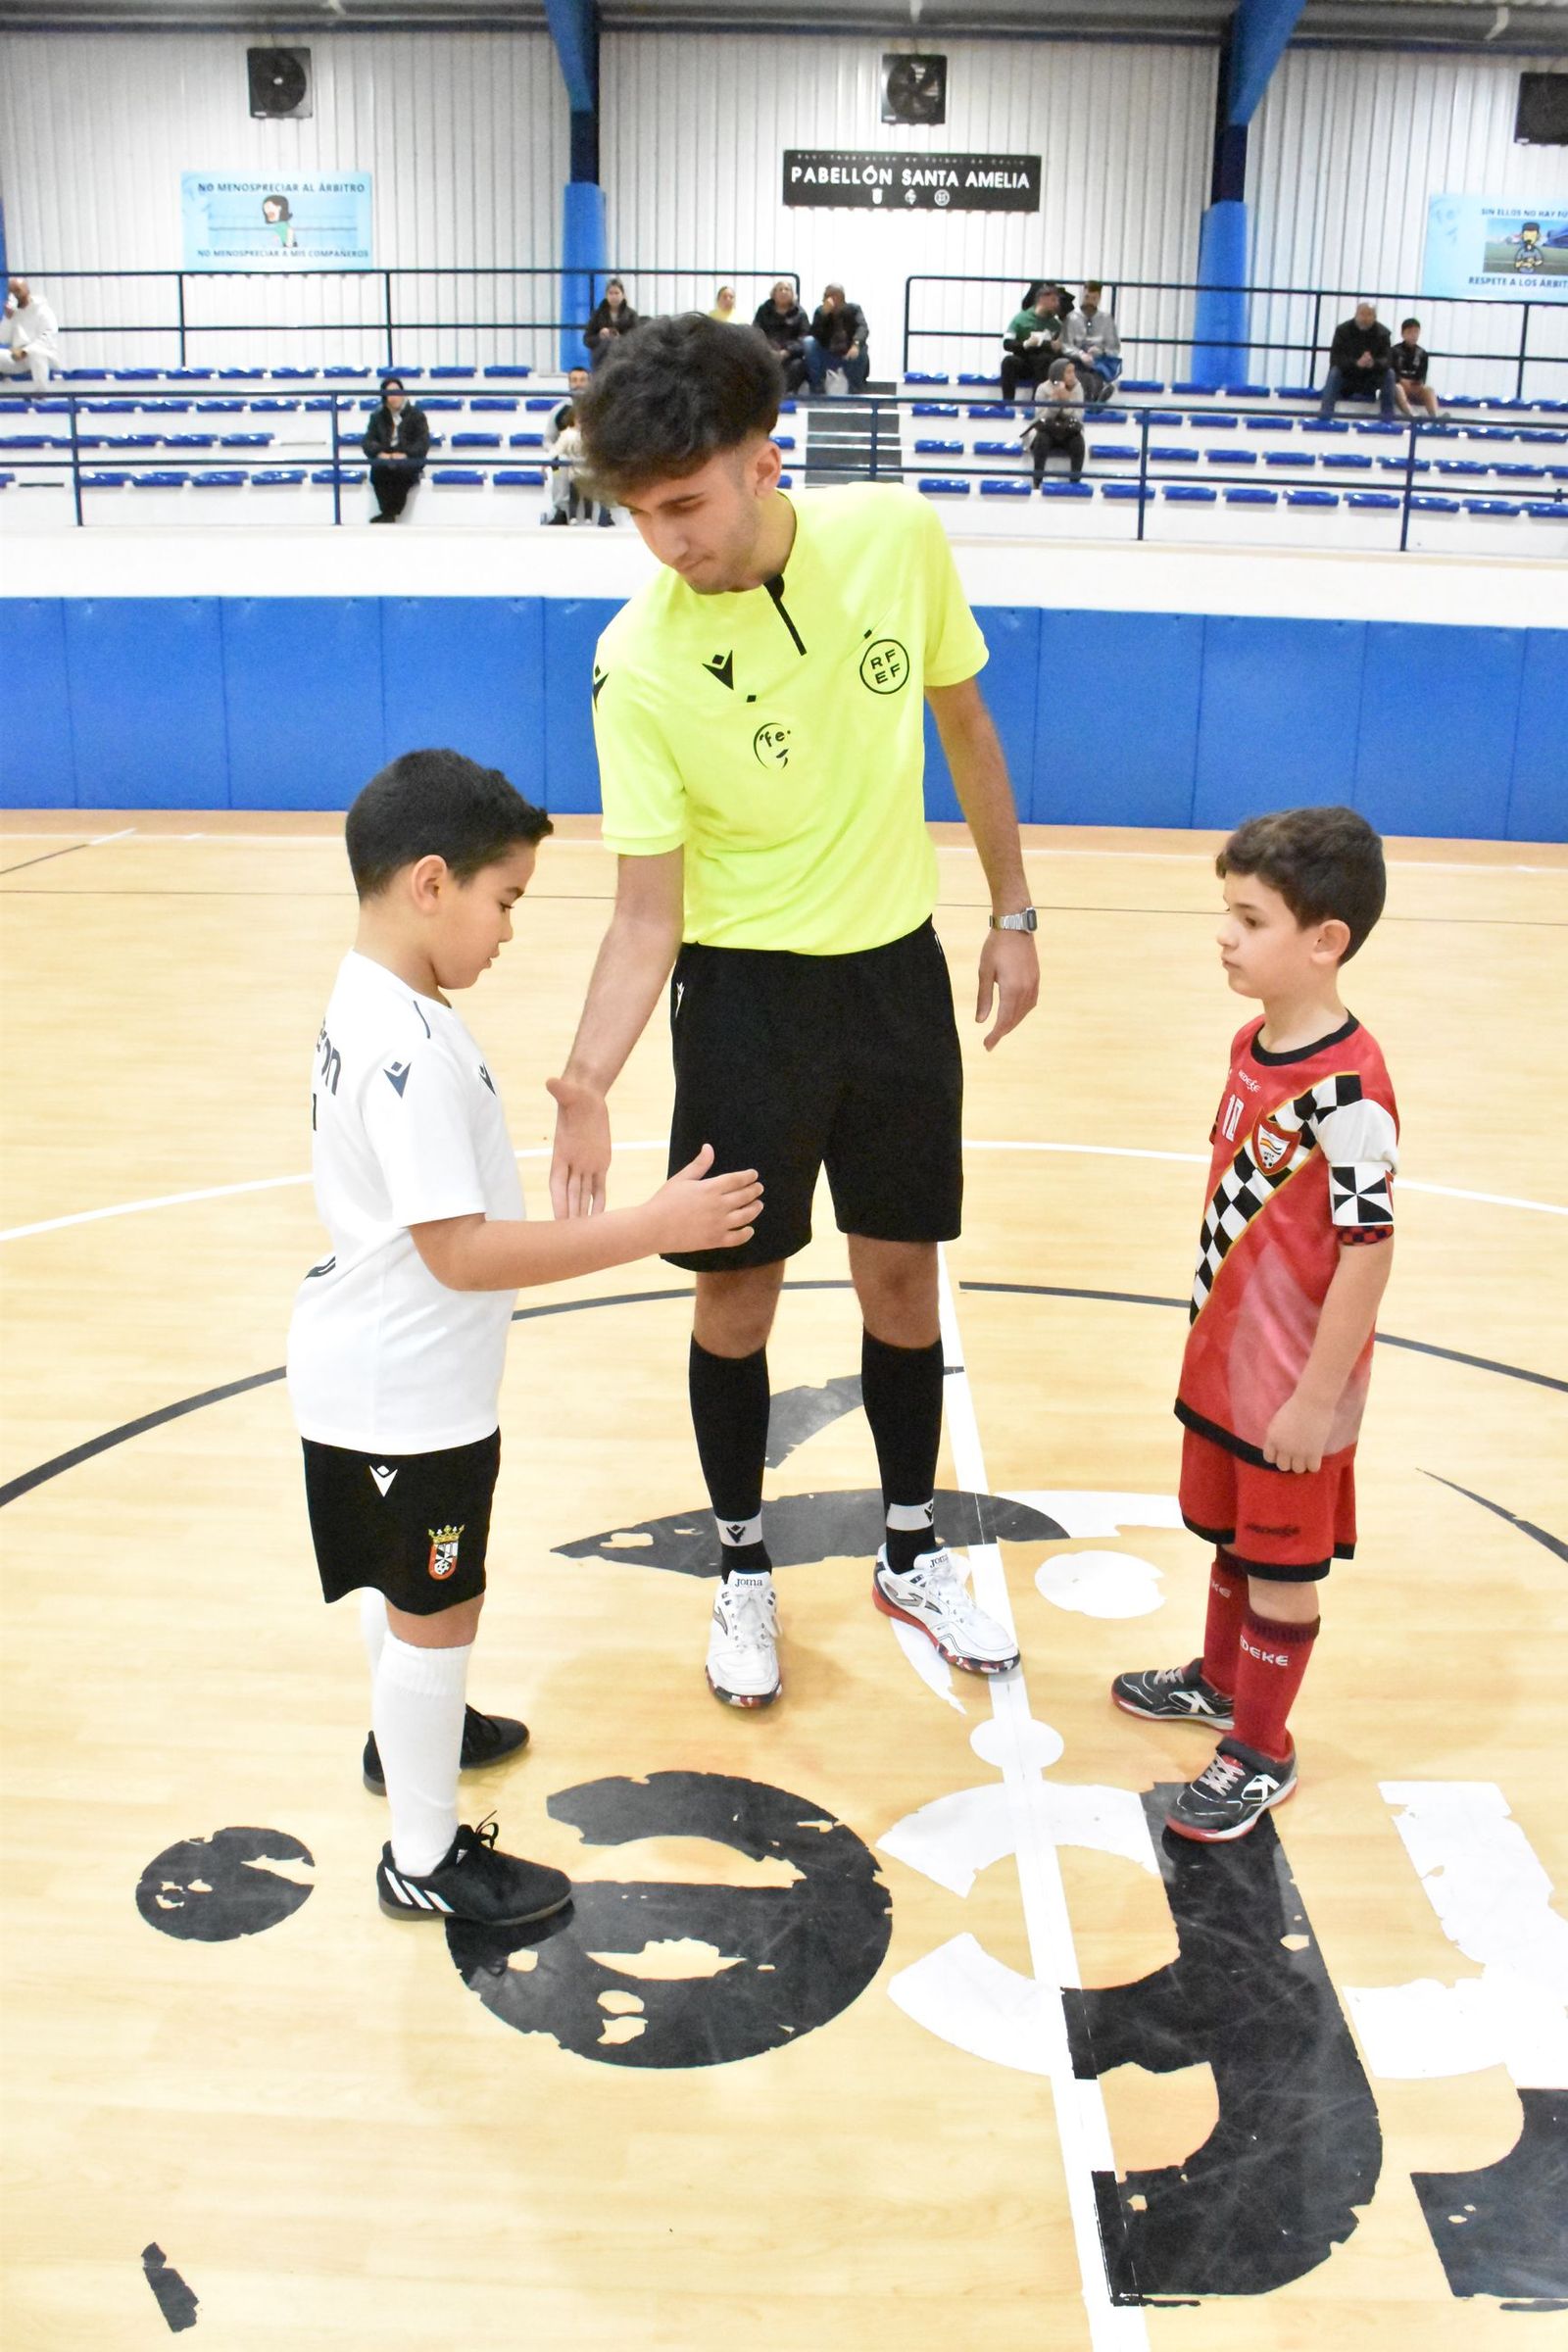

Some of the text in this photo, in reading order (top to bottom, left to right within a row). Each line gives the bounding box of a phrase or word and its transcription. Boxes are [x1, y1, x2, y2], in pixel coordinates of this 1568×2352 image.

[791, 165, 1030, 188] PABELLÓN SANTA AMELIA
[198, 181, 366, 193] NO MENOSPRECIAR AL ÁRBITRO
[1496, 208, 1521, 217] ELLOS
[1523, 209, 1537, 218] NO
[197, 249, 212, 258] NO
[213, 249, 279, 258] MENOSPRECIAR
[281, 249, 288, 258] A
[290, 249, 306, 258] MIS
[1468, 276, 1507, 286] RESPETE
[1508, 277, 1516, 286] A
[1518, 278, 1538, 287] LOS
